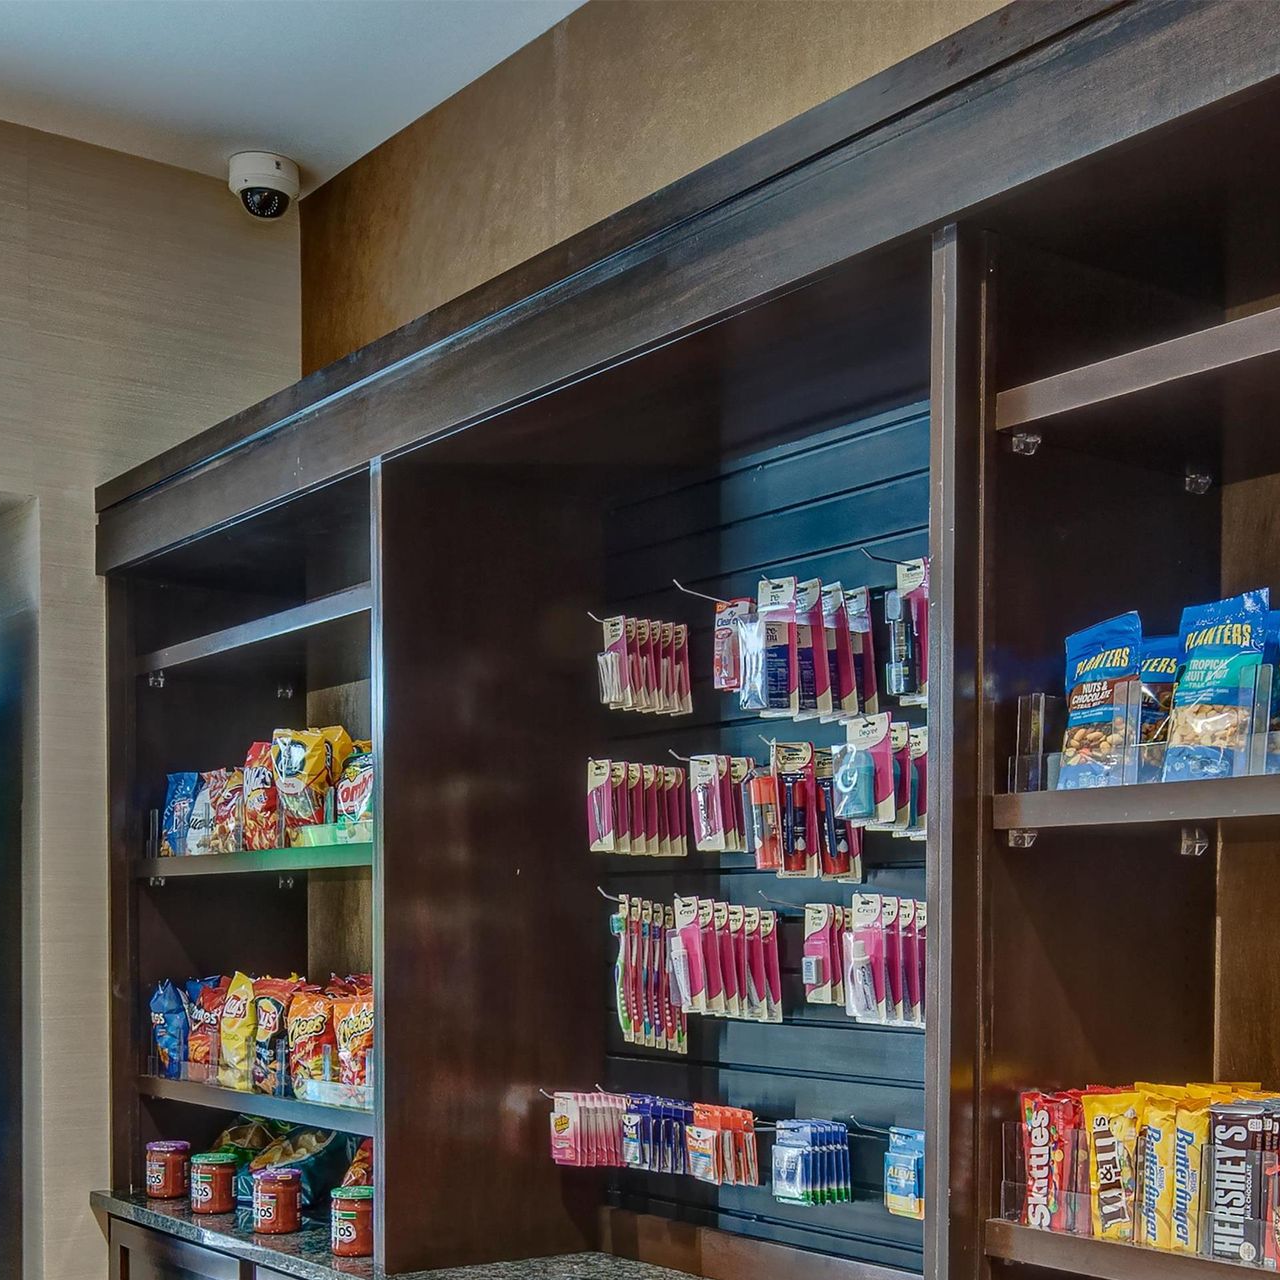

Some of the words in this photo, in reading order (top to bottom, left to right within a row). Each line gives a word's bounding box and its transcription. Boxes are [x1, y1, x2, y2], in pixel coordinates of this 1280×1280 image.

[1185, 624, 1251, 653] PLANTERS
[1075, 647, 1130, 681] PLANTERS
[1072, 689, 1112, 704] CHOCOLATE
[1082, 683, 1102, 693] NUTS
[857, 906, 876, 914] Crest
[888, 1167, 915, 1179] ALEVE
[1028, 1109, 1051, 1229] Skittles
[1245, 1164, 1253, 1203] CHOCOLATE
[1173, 1127, 1195, 1246] Butterfinger
[1214, 1125, 1248, 1254] HERSHEY'S
[1245, 1203, 1254, 1220] MILK
